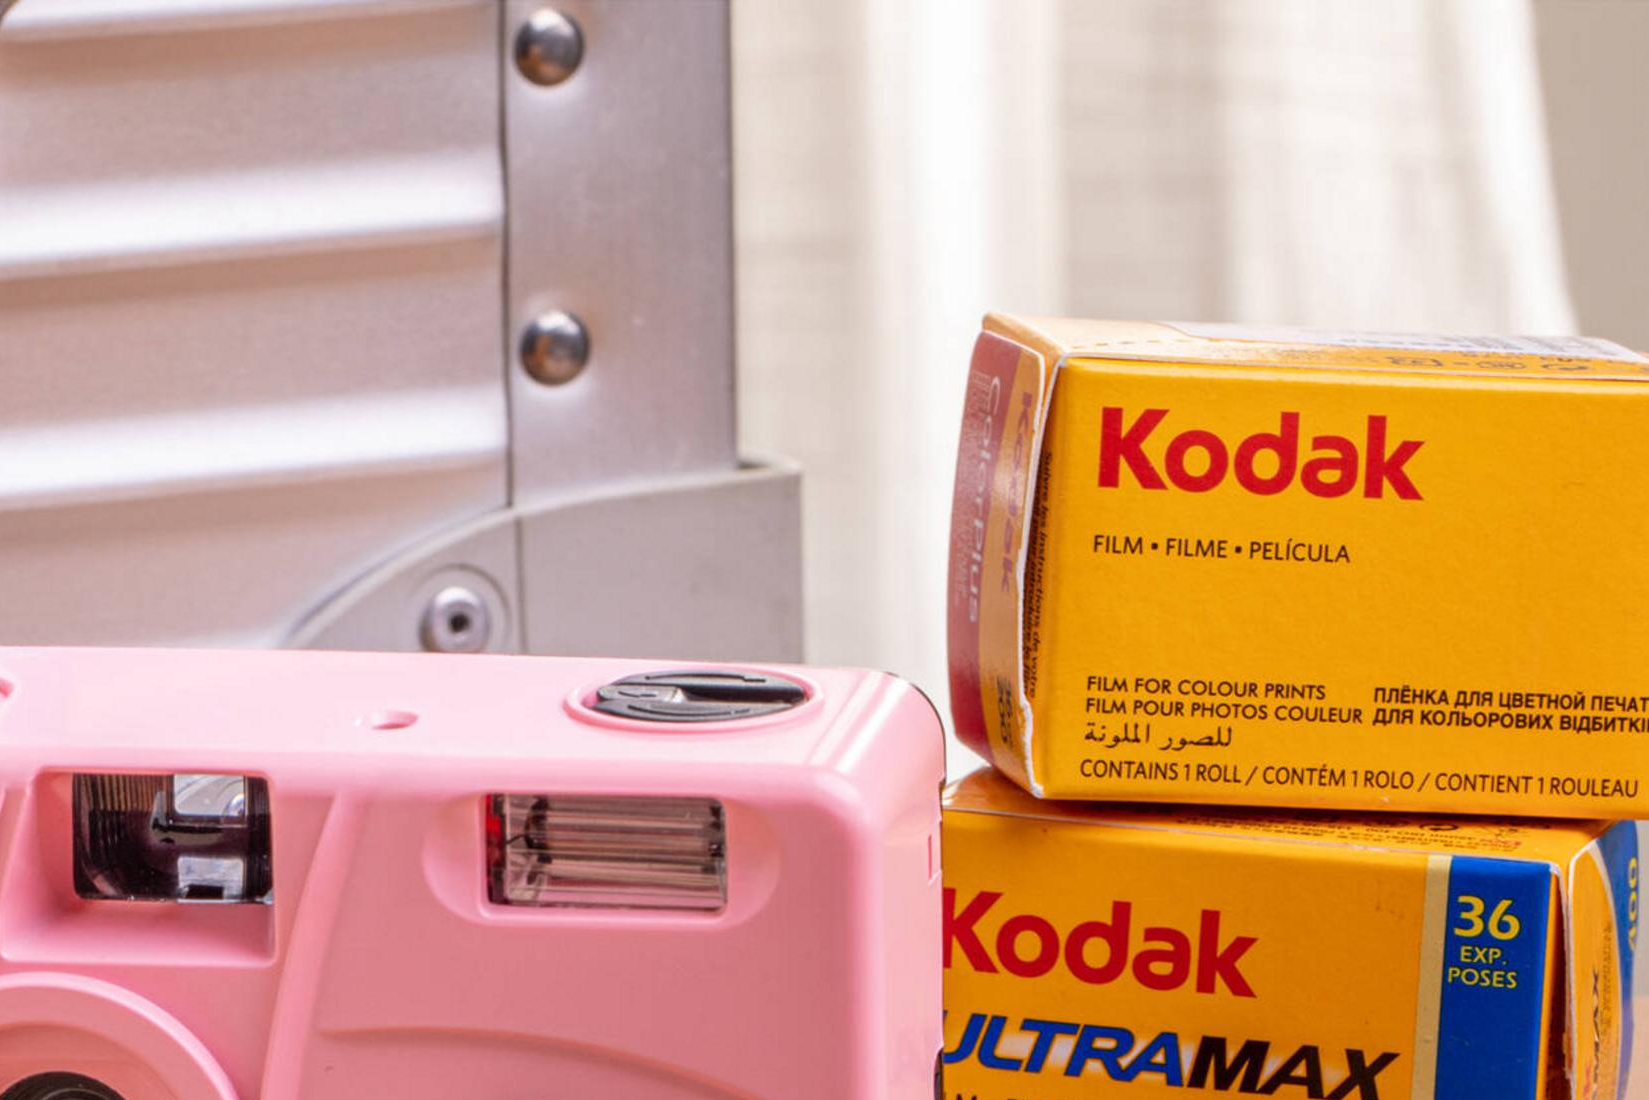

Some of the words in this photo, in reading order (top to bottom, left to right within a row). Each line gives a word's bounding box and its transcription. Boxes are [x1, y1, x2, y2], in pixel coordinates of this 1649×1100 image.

[1097, 406, 1426, 501] Kodak
[1093, 534, 1144, 555] FILM
[1165, 537, 1228, 559] FILME
[1249, 538, 1351, 563] PELÍCULA
[1087, 675, 1128, 693] FILM
[1134, 678, 1172, 695] FOR
[1177, 679, 1259, 698] COLOUR
[1264, 682, 1326, 700] PRINTS
[1373, 685, 1450, 705] ПЛЁНКА
[1454, 690, 1494, 708] ДЛЯ
[1498, 691, 1586, 711] ЦВЕТНОЙ
[1085, 697, 1127, 714] FILM
[1132, 699, 1185, 717] POUR
[1190, 702, 1269, 720] PHOTOS
[1274, 705, 1364, 724] COULEUR
[1372, 708, 1414, 726] ДЛЯ
[1419, 709, 1553, 731] КОЛЬОРОВИХ
[1084, 721, 1151, 748] الملونة
[1159, 725, 1232, 751] للصور
[1080, 758, 1179, 781] CONTAINS
[1184, 763, 1191, 782] 1
[1196, 763, 1242, 784] ROLL
[1262, 764, 1347, 788] CONTÉM
[1351, 769, 1359, 788] 1
[1363, 770, 1415, 790] ROLO
[1434, 772, 1534, 795] CONTIENT
[1537, 777, 1545, 795] 1
[1549, 777, 1639, 798] ROULEAU
[1453, 895, 1521, 940] 36
[942, 886, 1260, 999] Kodak
[1460, 945, 1508, 966] EXP.
[1447, 966, 1518, 989] POSES
